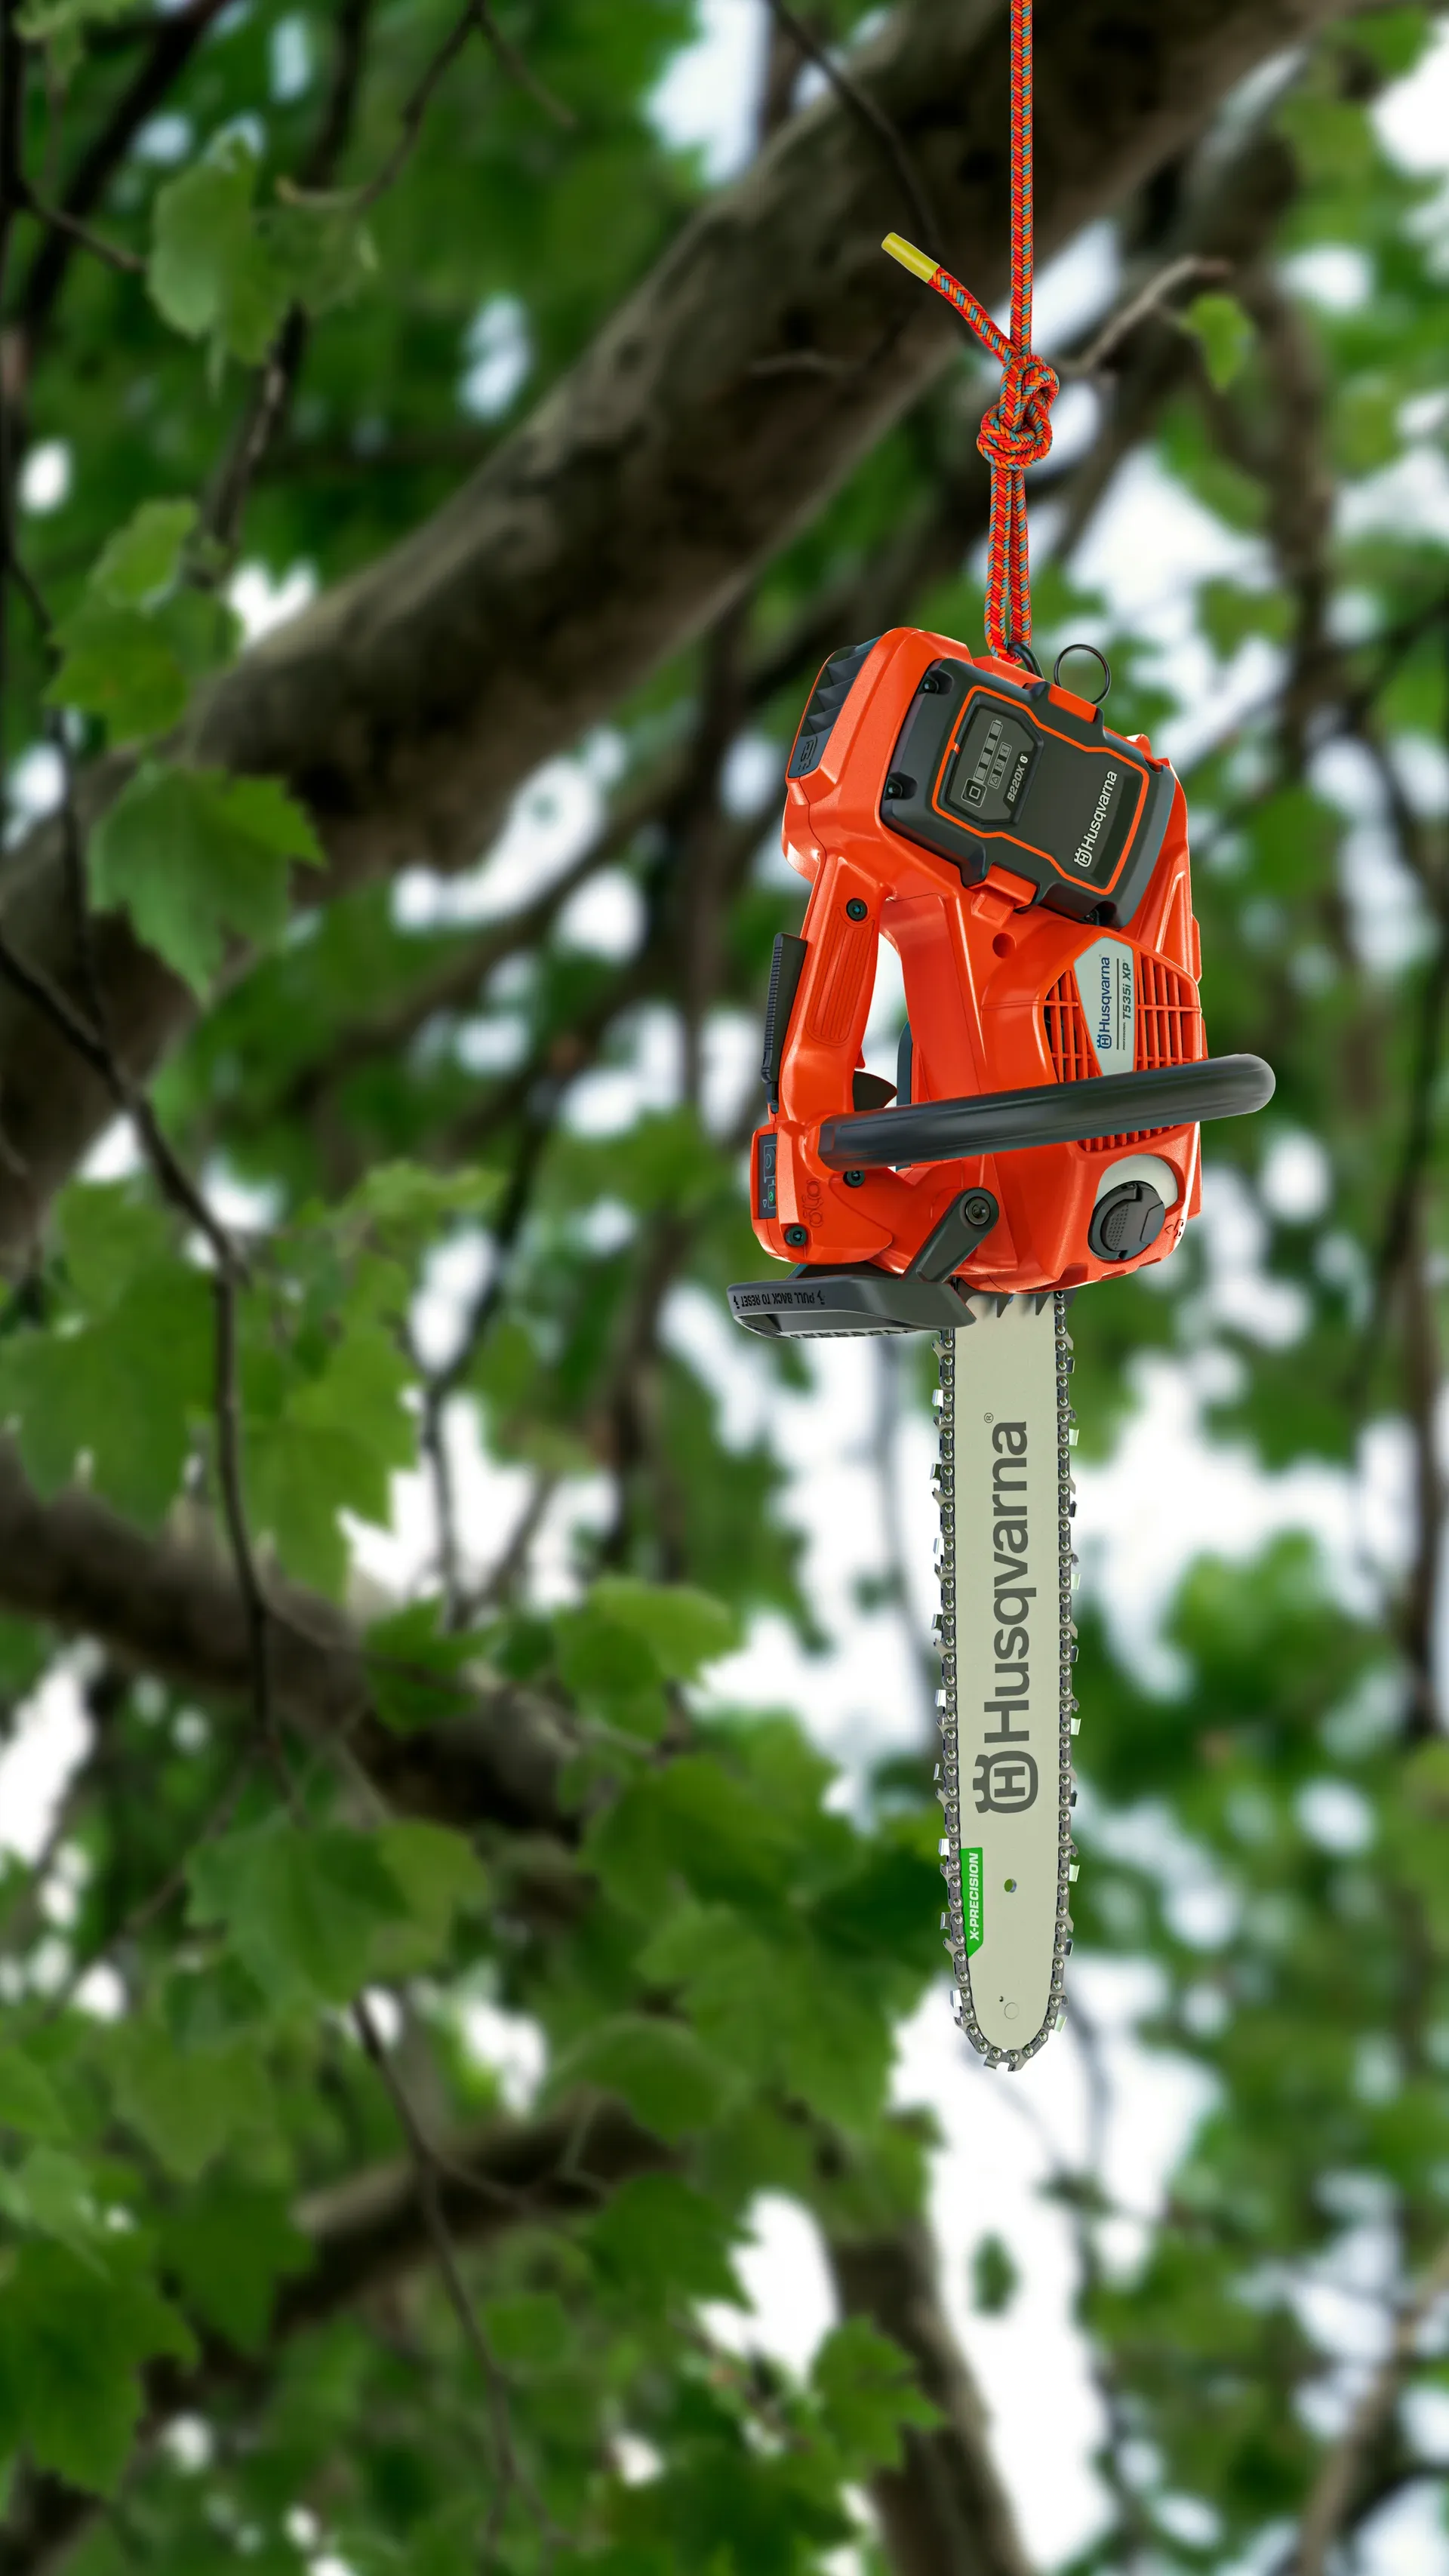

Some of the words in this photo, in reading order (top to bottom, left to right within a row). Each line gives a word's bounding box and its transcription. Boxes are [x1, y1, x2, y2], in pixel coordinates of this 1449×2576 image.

[1007, 764, 1025, 802] B220X
[1081, 771, 1118, 851] Husqvarna
[1122, 962, 1131, 981] XP
[1099, 957, 1112, 1033] Husqvarna
[1122, 983, 1131, 1020] T535i
[740, 1294, 761, 1307] RESET
[761, 1293, 771, 1305] TO
[771, 1292, 793, 1304] BACK
[794, 1292, 815, 1304] PULL
[983, 1420, 1037, 1743] Husqvarna
[969, 1852, 979, 1940] X-PRECISION
